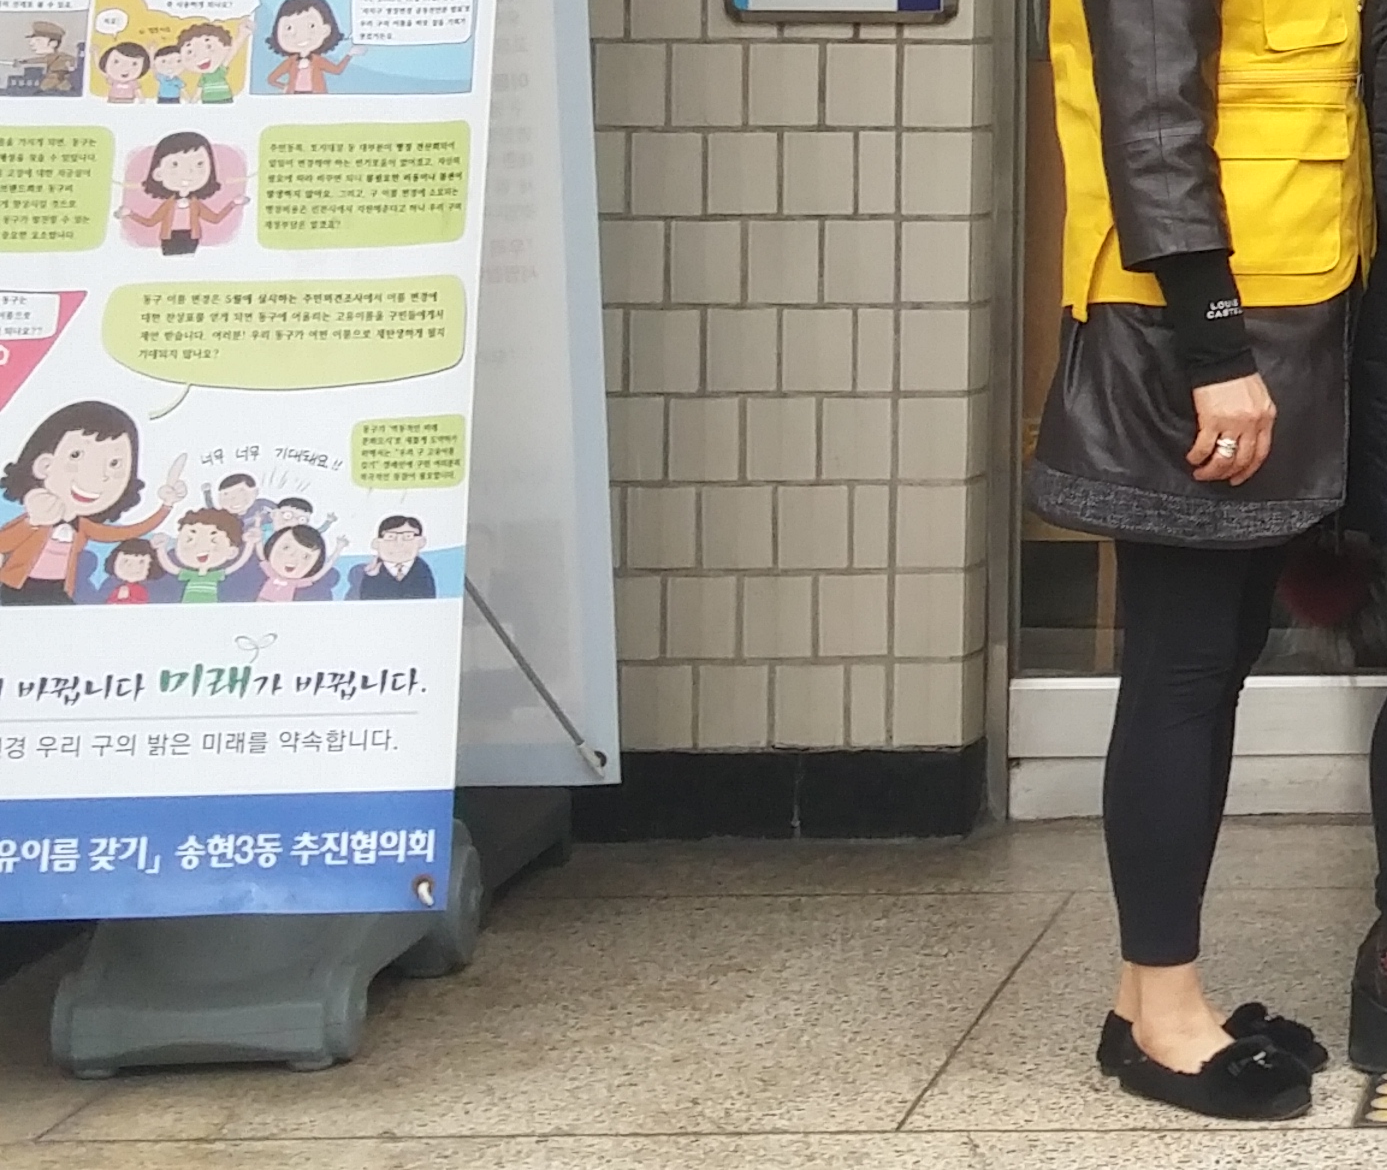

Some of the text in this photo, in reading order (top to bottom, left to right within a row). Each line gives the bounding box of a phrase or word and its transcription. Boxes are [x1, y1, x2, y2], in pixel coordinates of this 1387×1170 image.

[18, 663, 428, 707] 바뀝니다 미래가 바뀝니다.
[0, 729, 399, 760] 경 우리 구의 밝은 미래를 약속합니다.
[174, 832, 283, 869] 송현3동
[290, 828, 436, 867] 추진협의회
